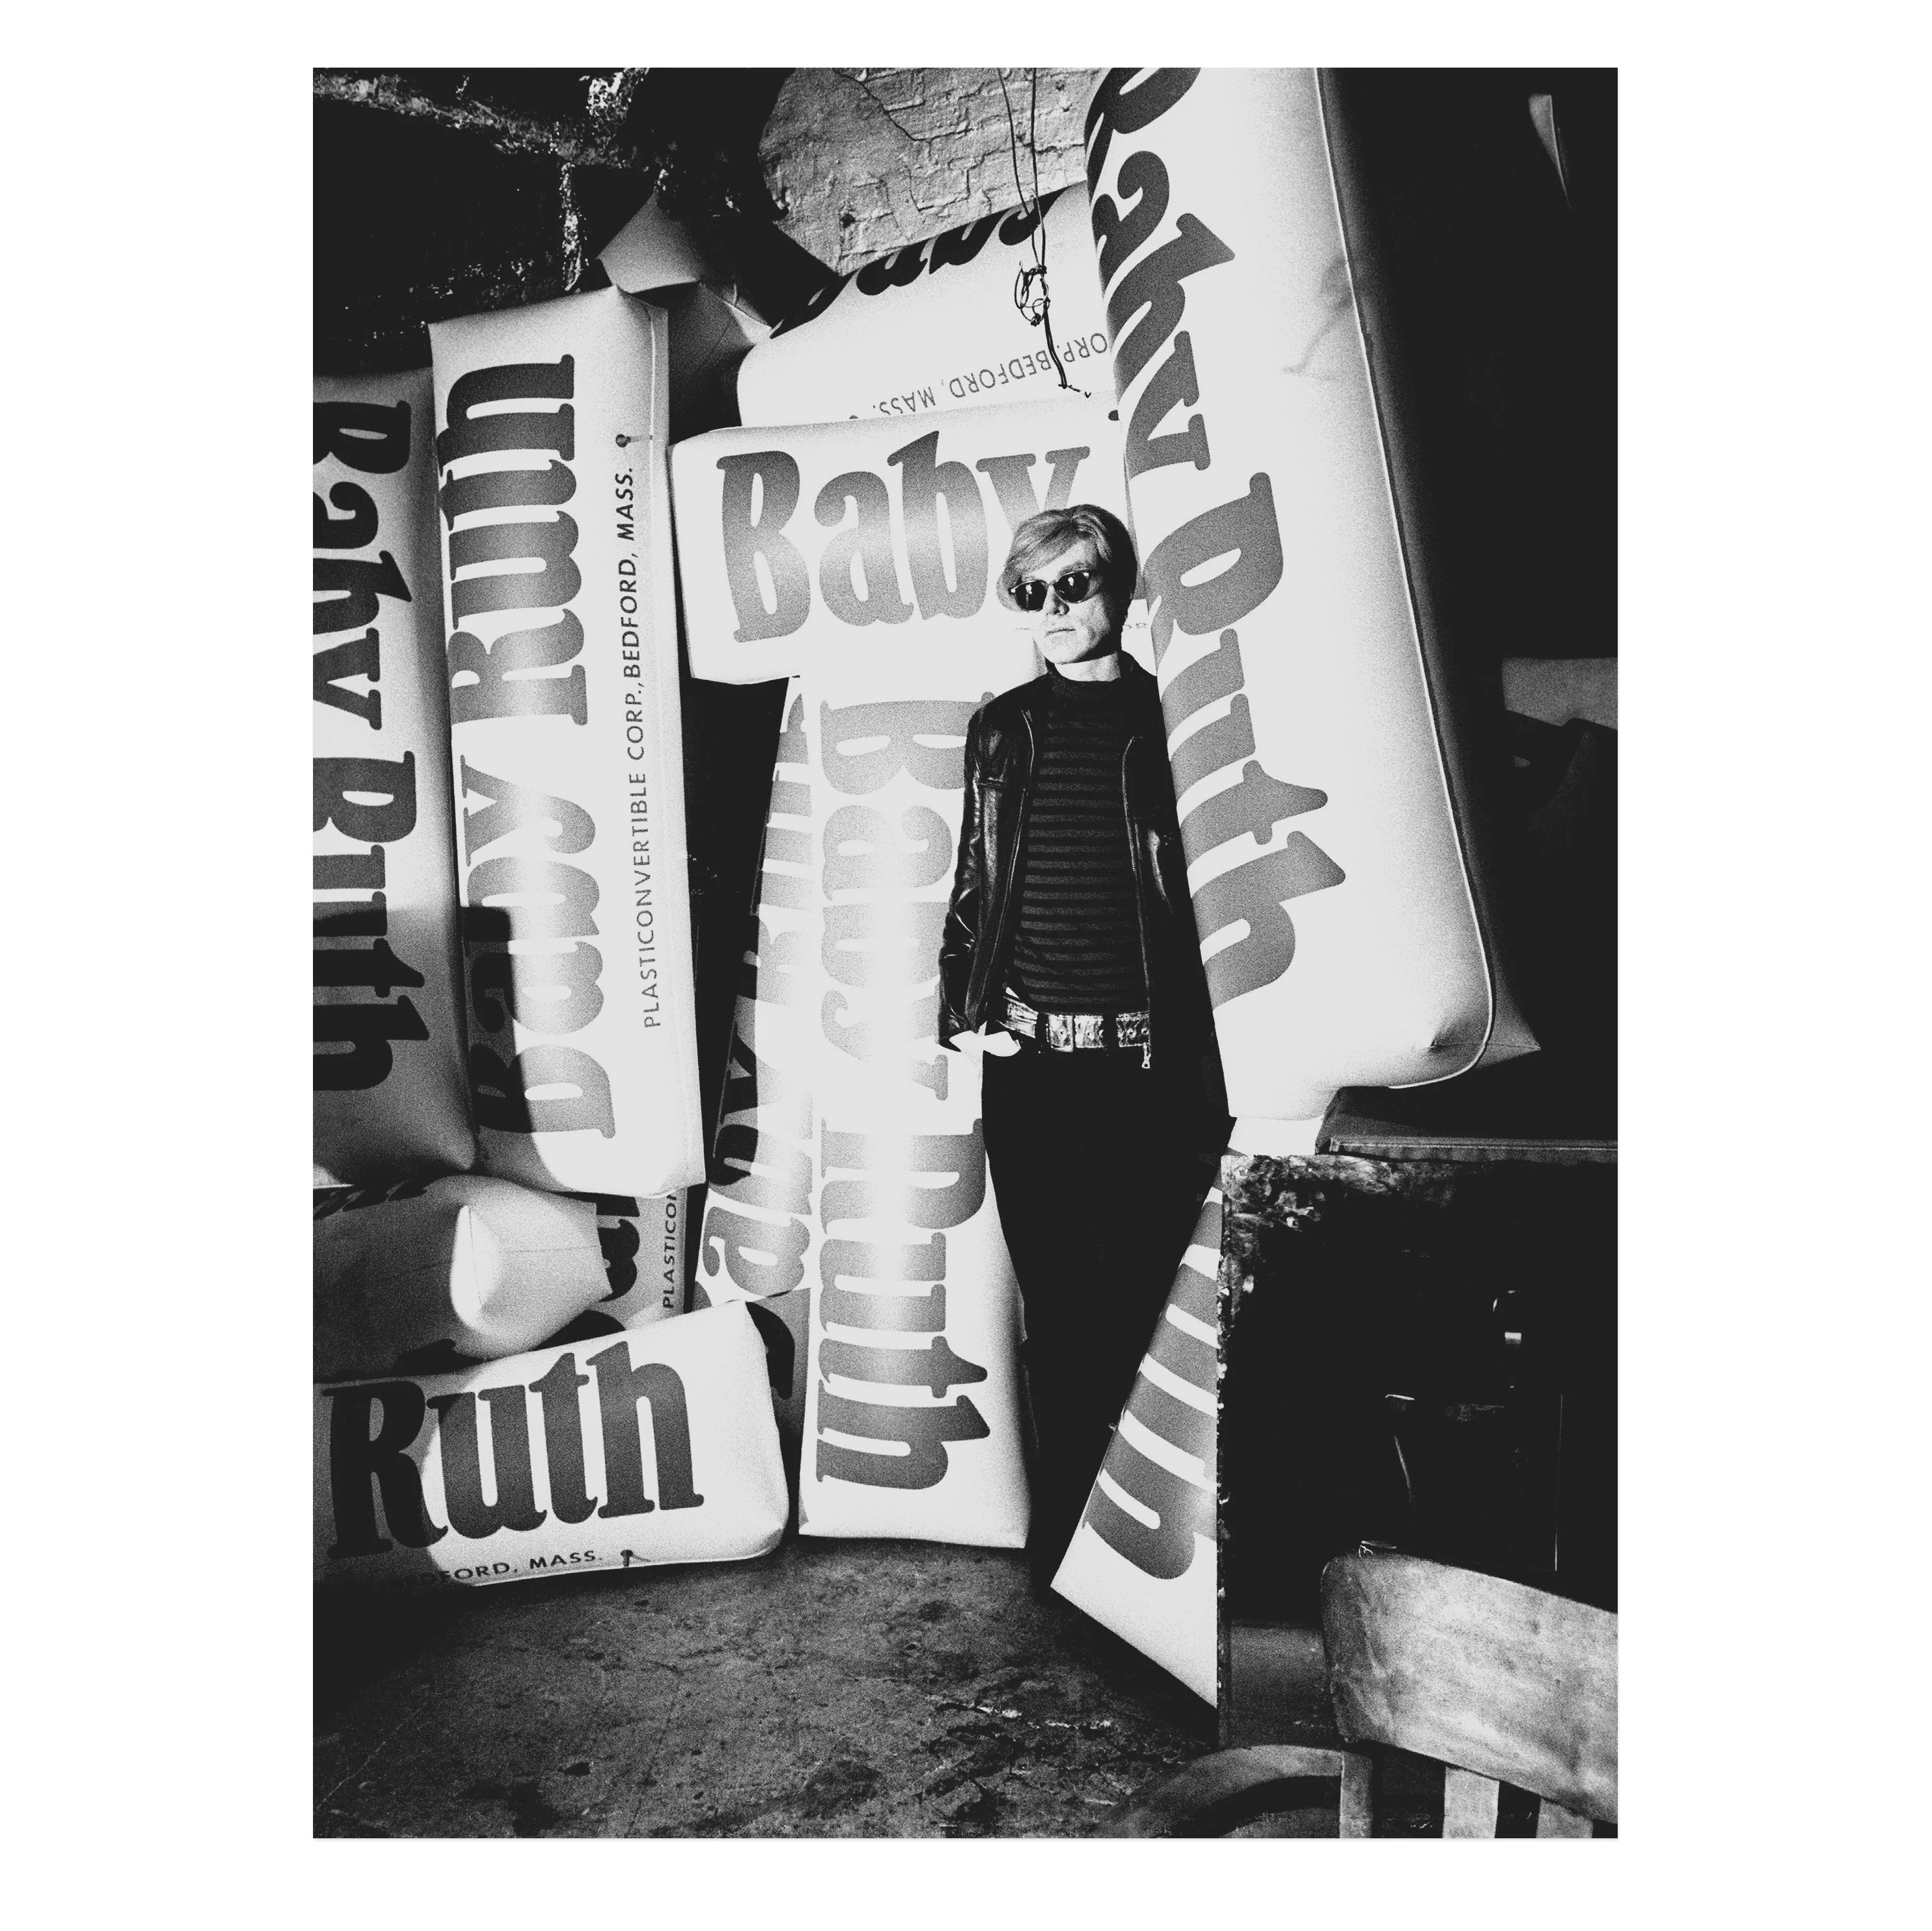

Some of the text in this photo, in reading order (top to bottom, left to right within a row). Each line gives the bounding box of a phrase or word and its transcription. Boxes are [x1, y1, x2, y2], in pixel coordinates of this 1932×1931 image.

[873, 386, 936, 415] MASS.
[1048, 332, 1108, 363] ORP.
[314, 400, 412, 731] Baby
[436, 353, 588, 726] Ruth
[615, 467, 634, 541] MASS.
[716, 431, 1090, 643] Baby
[1142, 472, 1346, 1011] Ruth
[314, 750, 430, 1091] Ruth
[460, 754, 616, 1140] Baby
[629, 773, 661, 1028] PLASTICONVERTIBLE
[816, 1118, 991, 1491] Ruth
[323, 1341, 704, 1559] Ruth
[529, 1550, 603, 1570] MASS.
